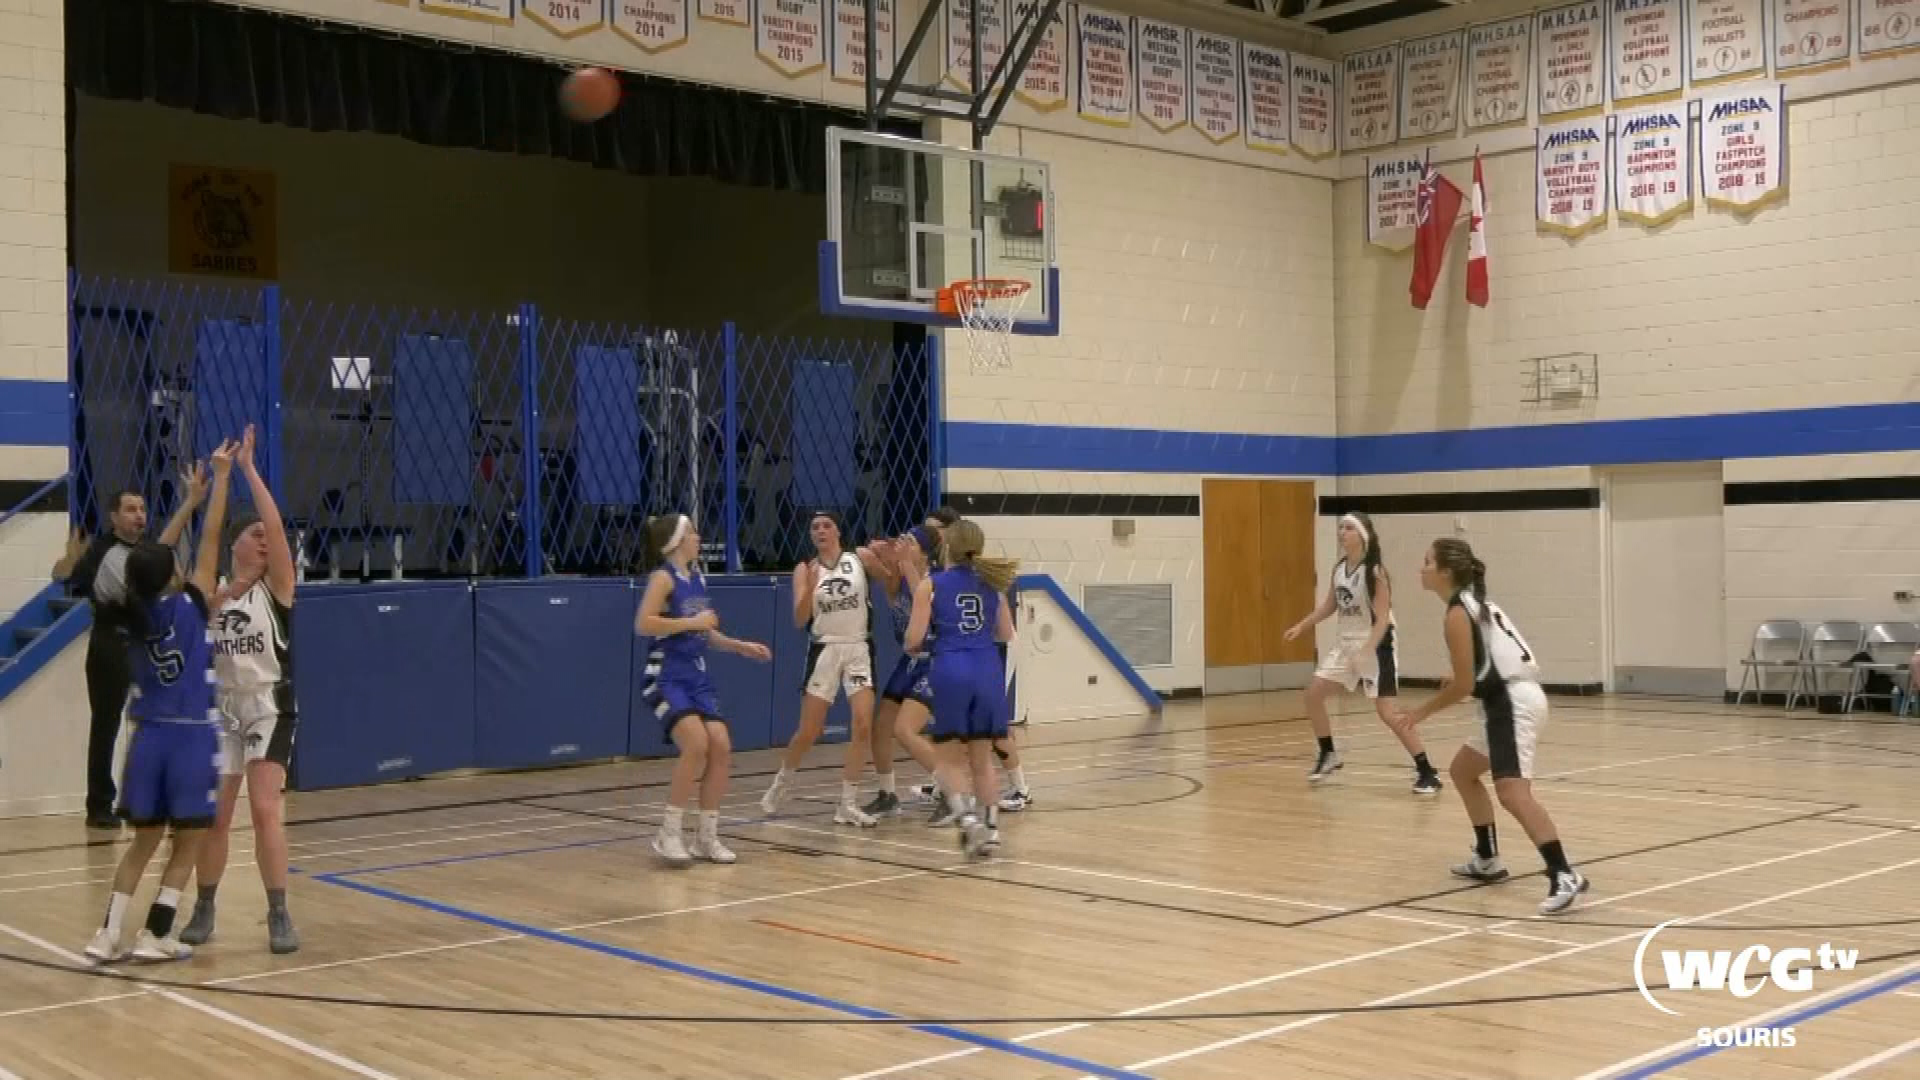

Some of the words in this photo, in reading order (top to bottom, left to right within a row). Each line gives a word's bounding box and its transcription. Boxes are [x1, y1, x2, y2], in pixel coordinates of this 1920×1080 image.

[549, 2, 579, 20] 2014
[624, 5, 676, 24] CHAMPIONS
[714, 2, 735, 16] 2015
[635, 21, 664, 38] 2014
[762, 14, 793, 31] VARSITY
[795, 21, 818, 35] GIRLS
[1702, 14, 1745, 30] FOOTBALL
[768, 29, 813, 48] CHAMPIONS
[1623, 34, 1669, 52] VOLLEYBALL
[1702, 30, 1746, 46] FINALISTS
[777, 45, 803, 62] 2015
[1622, 46, 1670, 63] CHAMPIONS
[1548, 64, 1592, 80] CHAMPIONS
[1153, 104, 1173, 119] 2016
[1708, 96, 1773, 122] MHSAA
[1207, 119, 1226, 132] 2016
[1621, 114, 1681, 138] MHSAA
[1721, 123, 1744, 136] ZONE
[1543, 128, 1600, 150] MHSAA
[1633, 138, 1655, 151] ZONE
[1727, 134, 1754, 147] GIRLS
[1555, 152, 1574, 164] ZONE
[1627, 149, 1676, 164] BADMINTON
[1716, 146, 1766, 161] FASTPITCH
[1543, 165, 1574, 177] VARSITY
[1578, 161, 1600, 173] BOYS
[1627, 162, 1677, 176] CHAMPIONS
[1715, 158, 1766, 174] CHAMPIONS
[1546, 174, 1597, 188] VOLLEYBALL
[1548, 185, 1595, 198] CHAMPIONS
[1630, 184, 1655, 198] 2018
[1663, 181, 1676, 194] 19
[818, 592, 859, 614] PANTHERS
[956, 592, 986, 634] 3
[146, 626, 185, 687] 5
